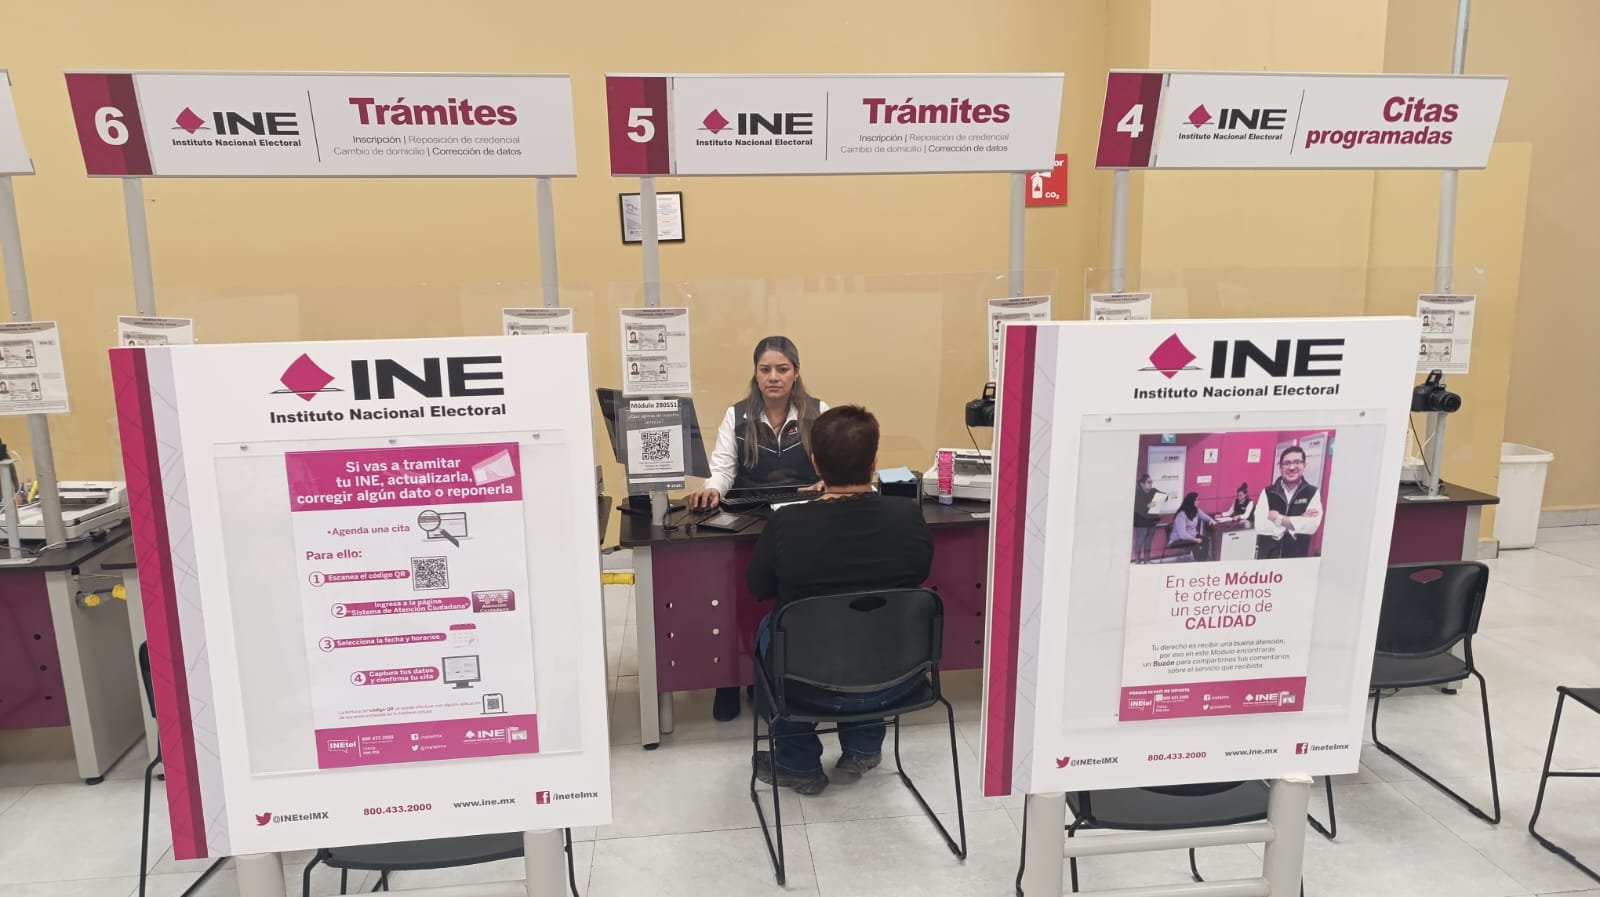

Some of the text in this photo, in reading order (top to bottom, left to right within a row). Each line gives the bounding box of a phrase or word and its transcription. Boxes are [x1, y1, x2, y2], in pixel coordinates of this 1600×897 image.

[348, 97, 518, 126] Trámites
[862, 97, 1010, 124] Trámites
[1383, 96, 1459, 122] Citas
[212, 112, 300, 135] INE
[627, 108, 654, 143] 5
[738, 113, 813, 135] INE
[1116, 104, 1144, 138] 4
[1217, 108, 1288, 130] INE
[94, 106, 129, 146] 6
[172, 138, 302, 147] Instituto Nacional Electoral
[352, 136, 520, 146] Inscripción Reposición de credencial
[858, 133, 1010, 143] Inscripción Reposición de credencial
[1304, 126, 1453, 149] programadas
[334, 146, 522, 156] Cambio de domicilio Corrección de datos
[840, 144, 1008, 154] Cambio de domicilio Corrección de datos
[1210, 338, 1345, 379] INE
[350, 355, 504, 400] INE
[1134, 384, 1340, 399] Instituto Nacional Electoral
[270, 403, 506, 424] Instituto Nacional Electoral
[346, 457, 461, 473] Si vas a tramitar
[336, 472, 473, 488] tu INE, actualizarla,
[297, 483, 513, 505] corregir algún dato o reponerla
[372, 525, 389, 534] una
[392, 524, 410, 533] cita
[306, 549, 362, 560] Para ello:
[313, 574, 320, 584] 1
[368, 572, 393, 580] código
[1166, 570, 1283, 588] En este Módulo
[1175, 588, 1272, 602] te ofrecemos
[336, 605, 344, 615] 2
[394, 606, 426, 614] Atención
[1170, 600, 1273, 617] un servicio de
[1185, 614, 1256, 630] CALIDAD
[324, 640, 332, 649] 3
[336, 638, 374, 646] Selecciona
[376, 636, 383, 644] la
[384, 635, 404, 643] fecha
[354, 674, 362, 683] 4
[369, 669, 398, 678] Captura
[1255, 693, 1278, 701] INE
[477, 729, 505, 738] INE
[1148, 751, 1206, 761] 800.433.2000
[1224, 748, 1278, 757] www.ine.mx
[1071, 756, 1118, 766] @INEtelMX
[552, 790, 598, 801] /inetelmx
[363, 803, 432, 816] 800.433.2000
[453, 798, 515, 809] www.ine.mx
[272, 811, 329, 824] @INEtelMX
